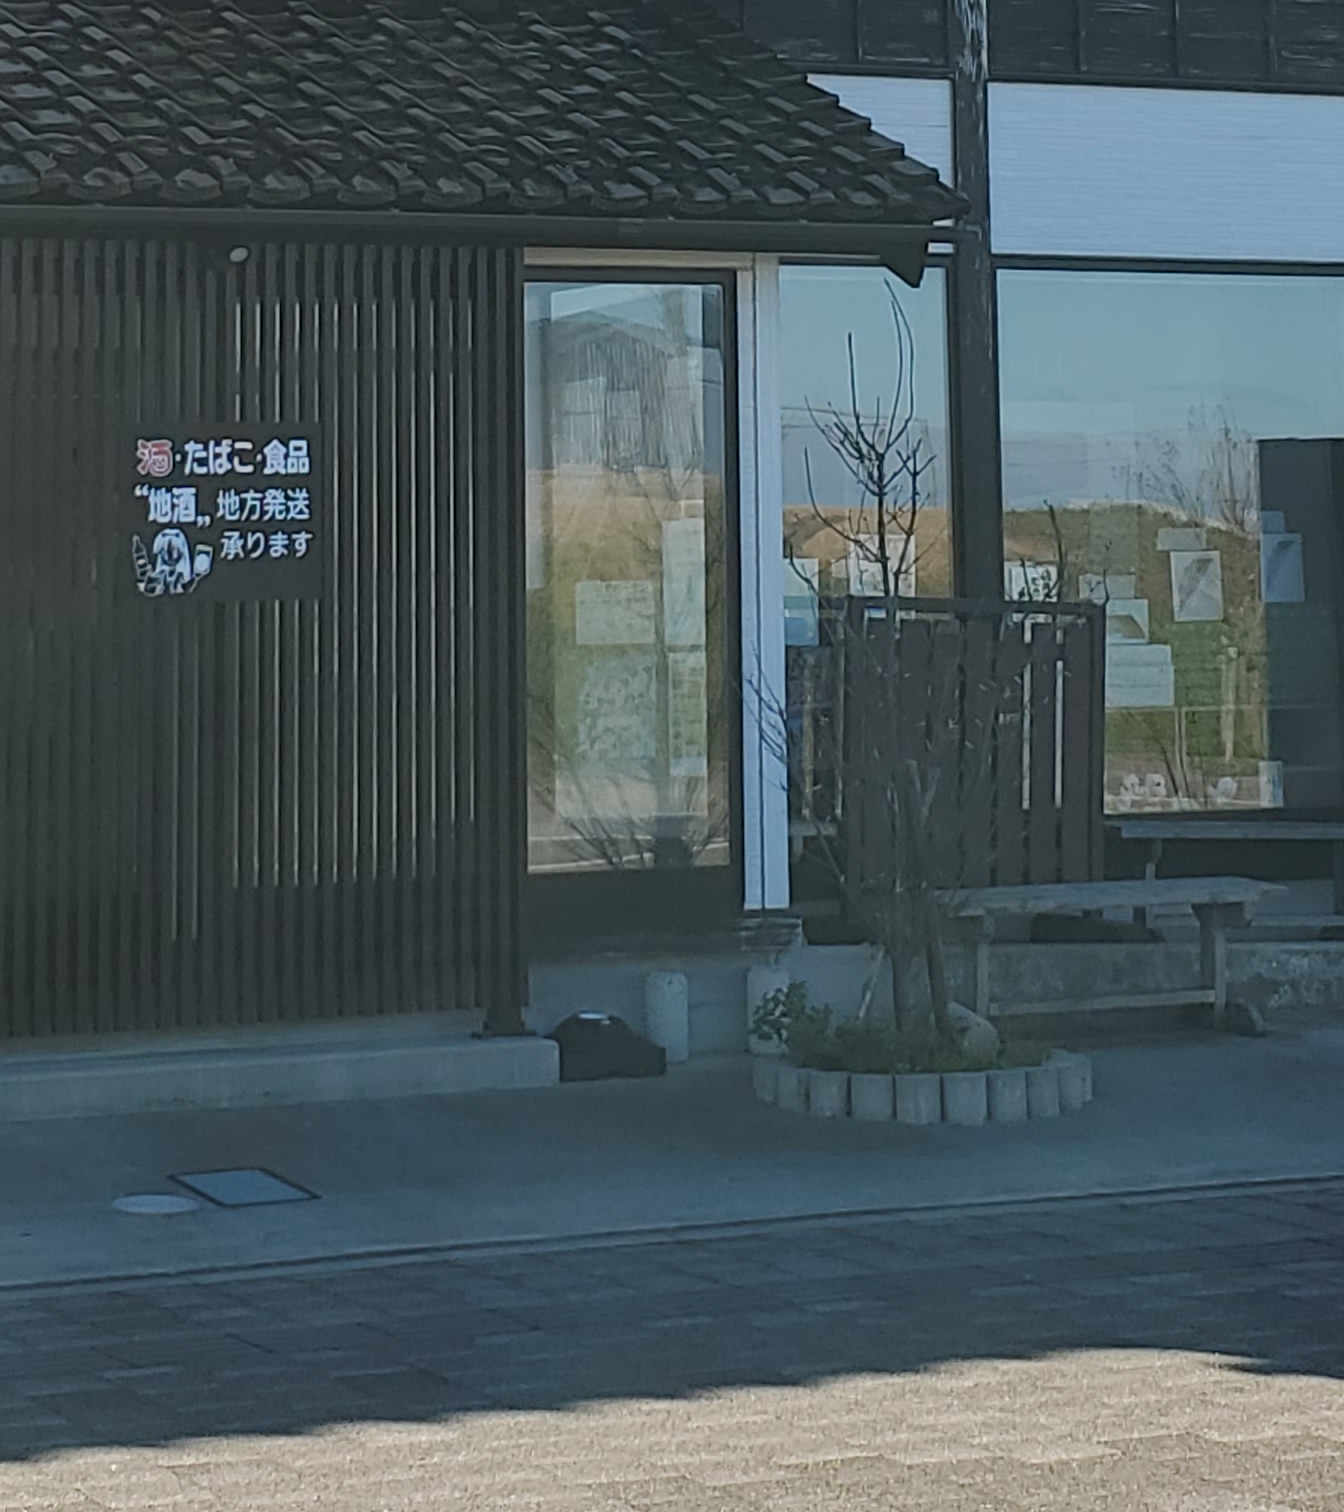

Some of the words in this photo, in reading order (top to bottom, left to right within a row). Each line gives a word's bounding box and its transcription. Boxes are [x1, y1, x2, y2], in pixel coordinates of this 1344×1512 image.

[216, 487, 312, 523] 地方発送
[219, 530, 313, 561] 承ります
